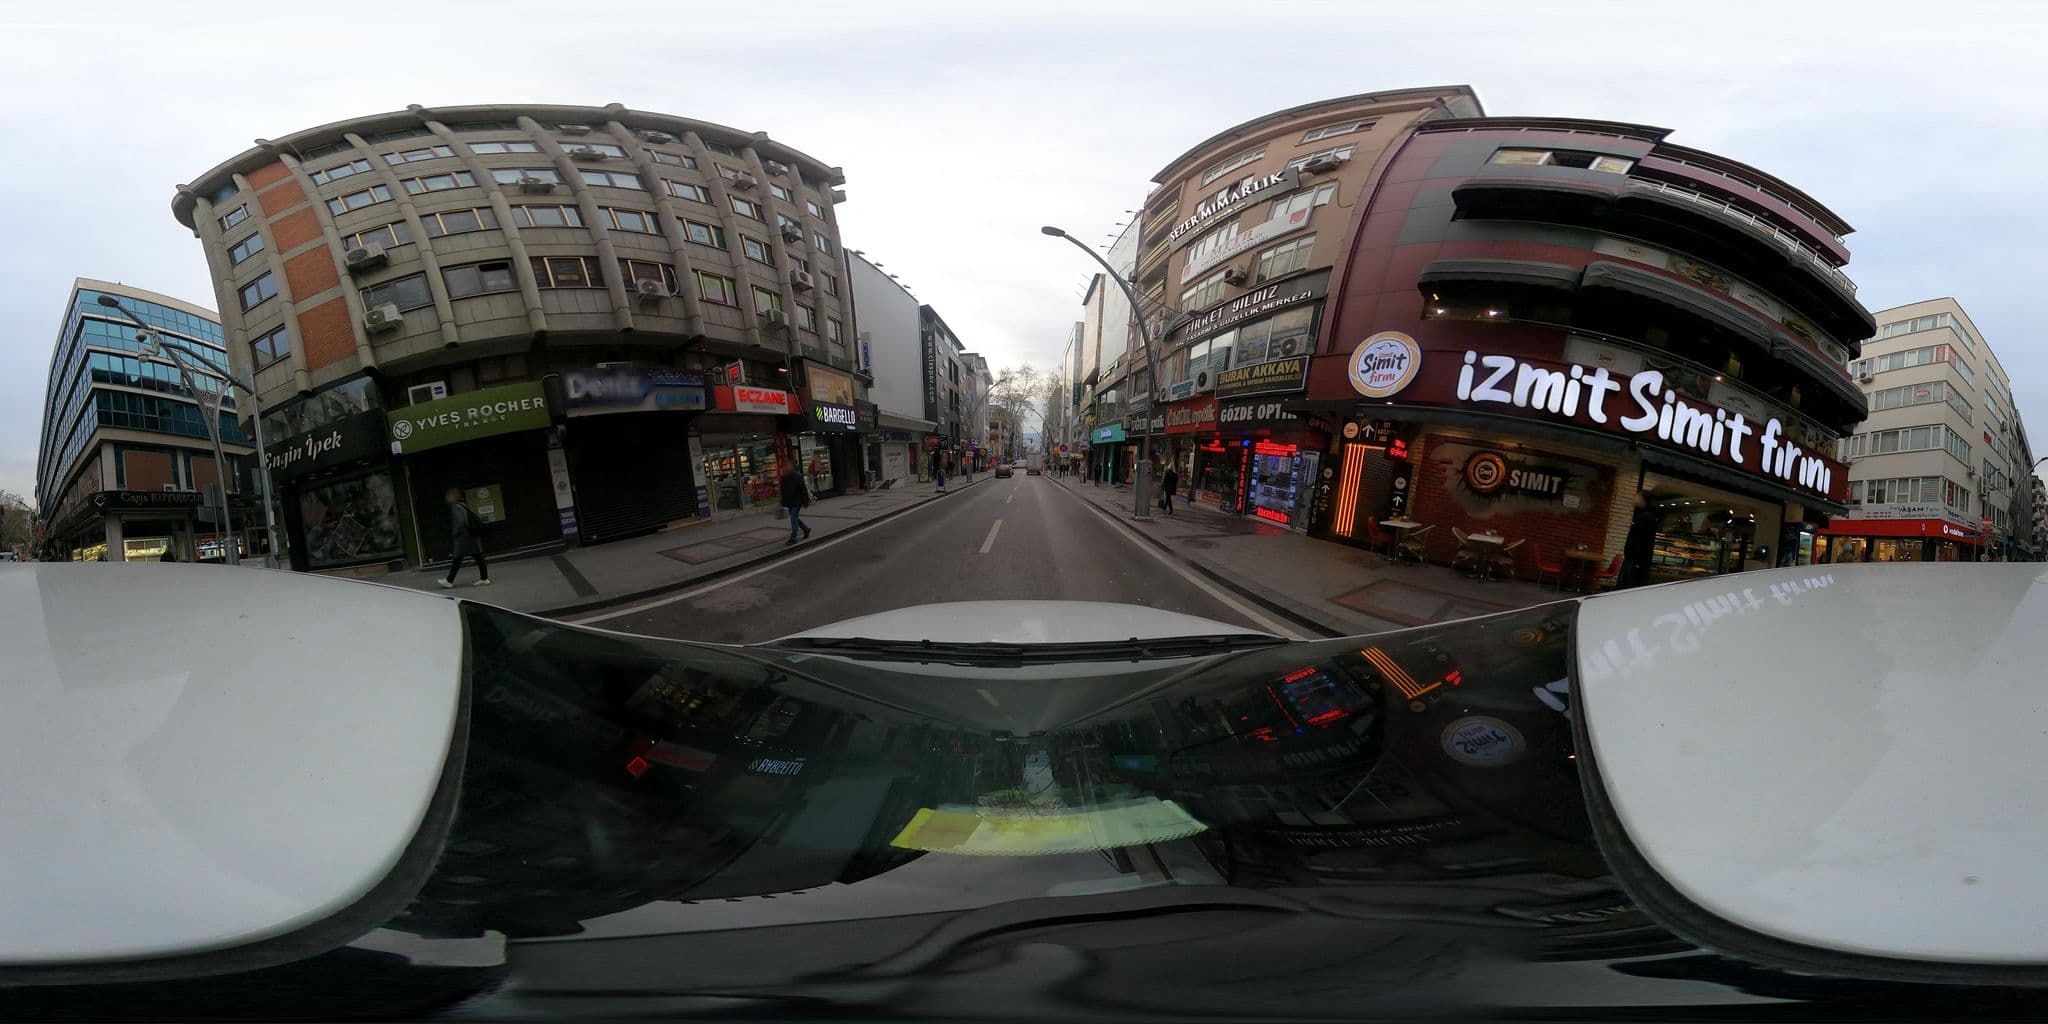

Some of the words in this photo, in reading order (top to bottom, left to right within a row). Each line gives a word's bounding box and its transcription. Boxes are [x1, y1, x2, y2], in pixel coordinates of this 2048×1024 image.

[1169, 214, 1199, 242] SEZER
[1232, 285, 1279, 312] YILDIZ
[1262, 290, 1313, 311] MERKEZİ
[1220, 368, 1250, 385] BURAK
[1252, 360, 1300, 378] AKKAYA
[1360, 353, 1408, 374] Simit
[738, 388, 786, 405] ECZANE
[416, 411, 461, 430] YVES
[467, 397, 546, 419] ROCHER
[823, 406, 856, 424] BARGELLO
[1221, 404, 1255, 422] GÖZDE
[1620, 370, 1752, 464] Simit
[264, 446, 302, 471] Engin
[305, 430, 343, 461] İpek
